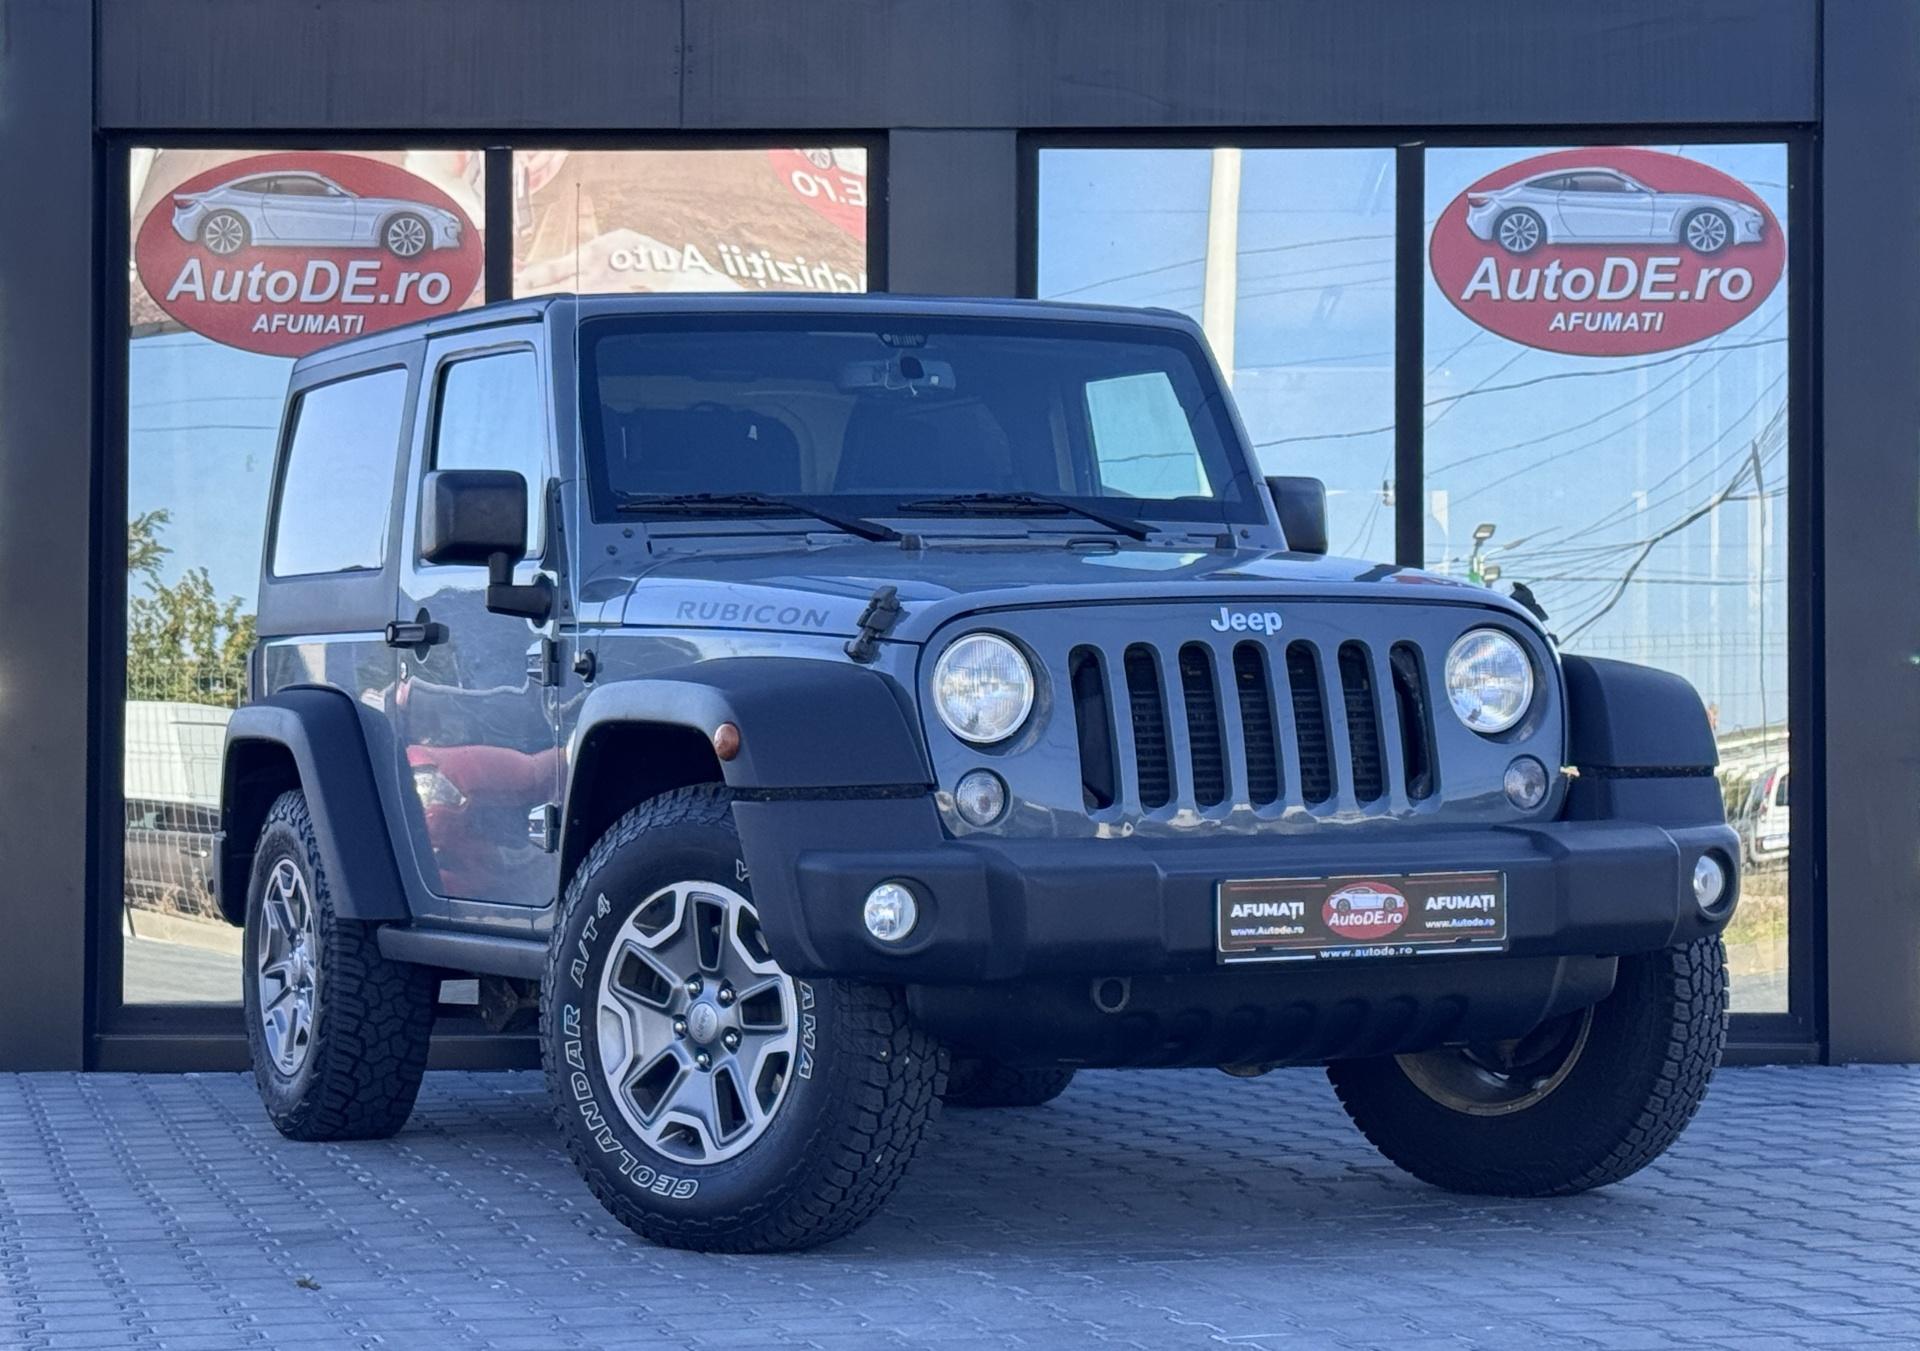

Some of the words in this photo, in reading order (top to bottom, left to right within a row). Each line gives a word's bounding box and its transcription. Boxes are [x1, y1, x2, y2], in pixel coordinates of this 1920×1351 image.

[167, 258, 452, 304] AutoDE.ro
[1461, 256, 1754, 302] AutoDE.ro
[253, 314, 364, 335] AFUMATI
[1549, 312, 1664, 332] AFUMATI
[676, 601, 830, 627] RUBICON
[1211, 607, 1283, 635] Jeep
[1328, 911, 1403, 927] AutoDE.ro
[1320, 946, 1413, 958] www.autode.ro
[564, 1003, 699, 1199] GEOLANDAR
